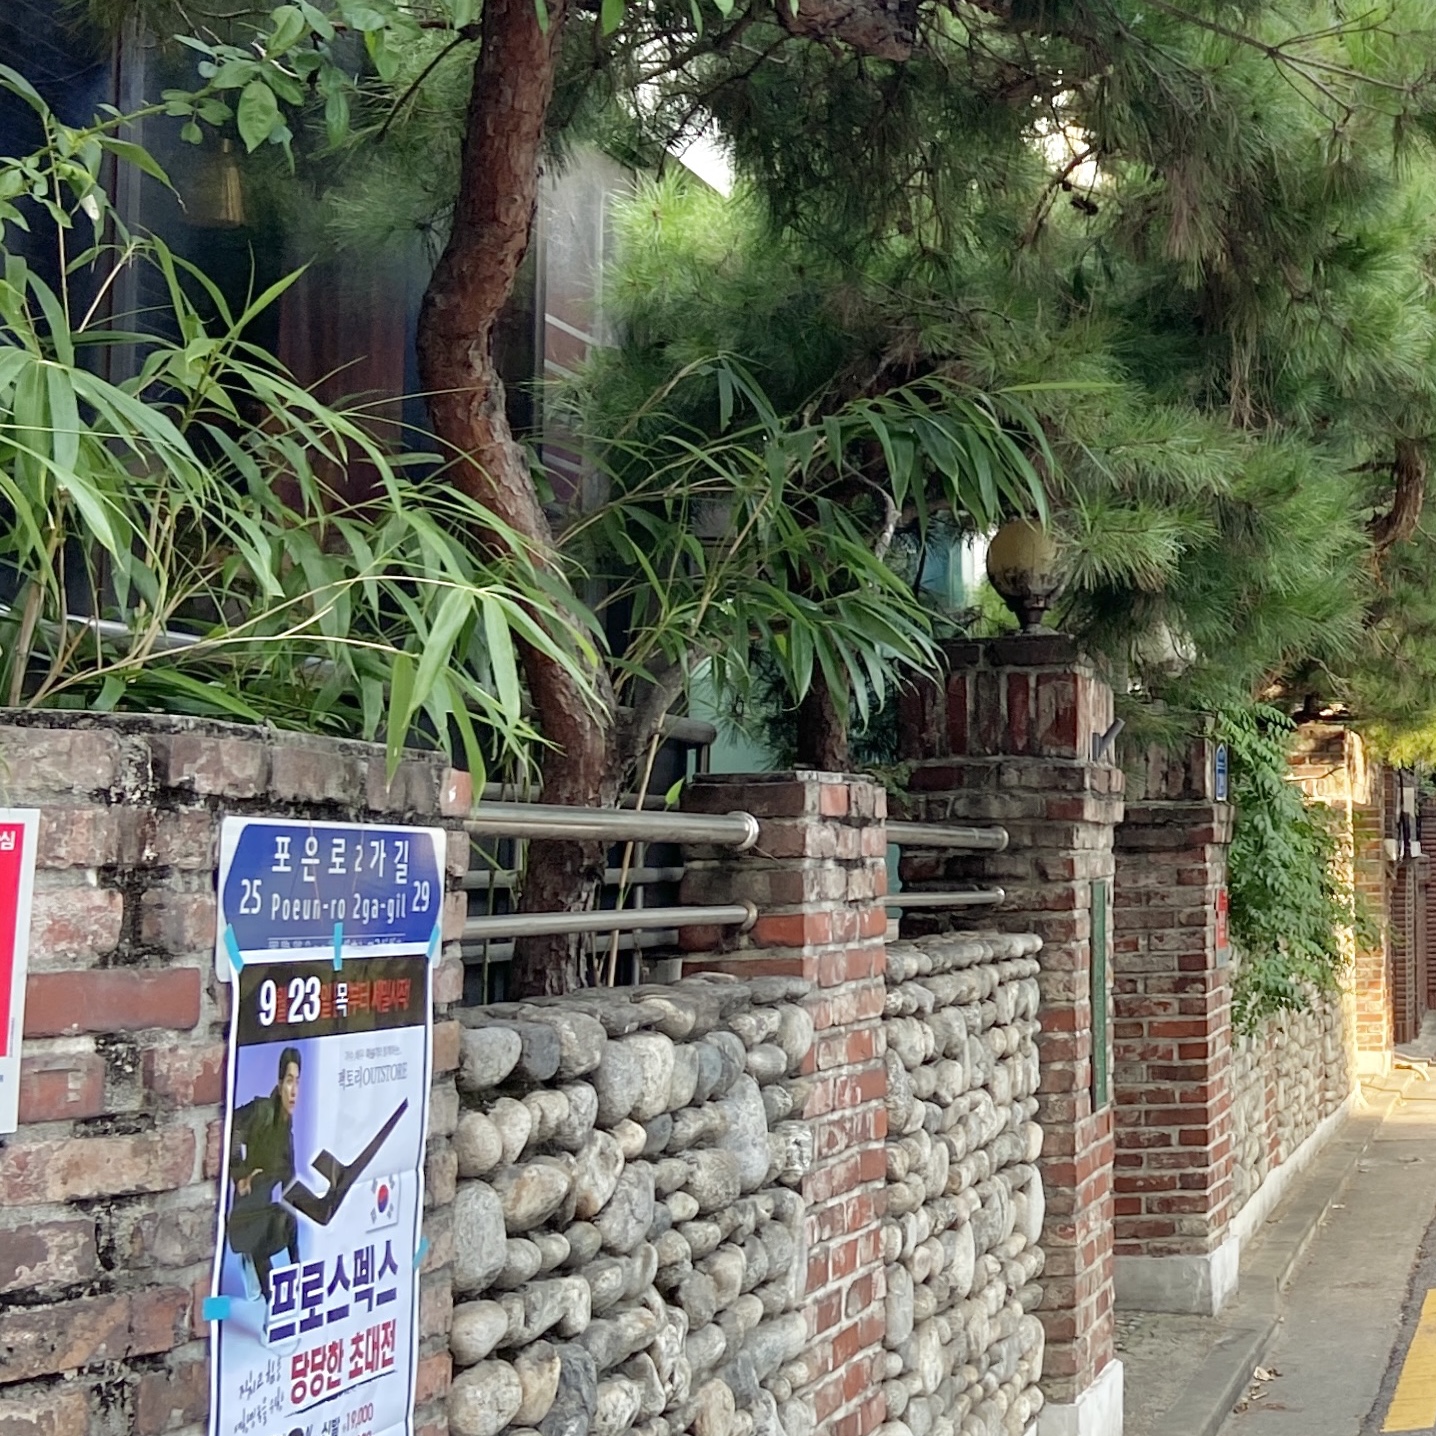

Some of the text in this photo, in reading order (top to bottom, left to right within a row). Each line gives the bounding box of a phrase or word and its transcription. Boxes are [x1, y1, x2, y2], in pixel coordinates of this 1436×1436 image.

[271, 836, 409, 884] 포은로2가길
[239, 879, 262, 914] 25
[271, 893, 406, 924] Poeun-ro 2ga-gil
[411, 881, 430, 912] 29
[268, 1240, 399, 1344] 프로스펙스
[290, 1319, 397, 1405] 당당한 초대전
